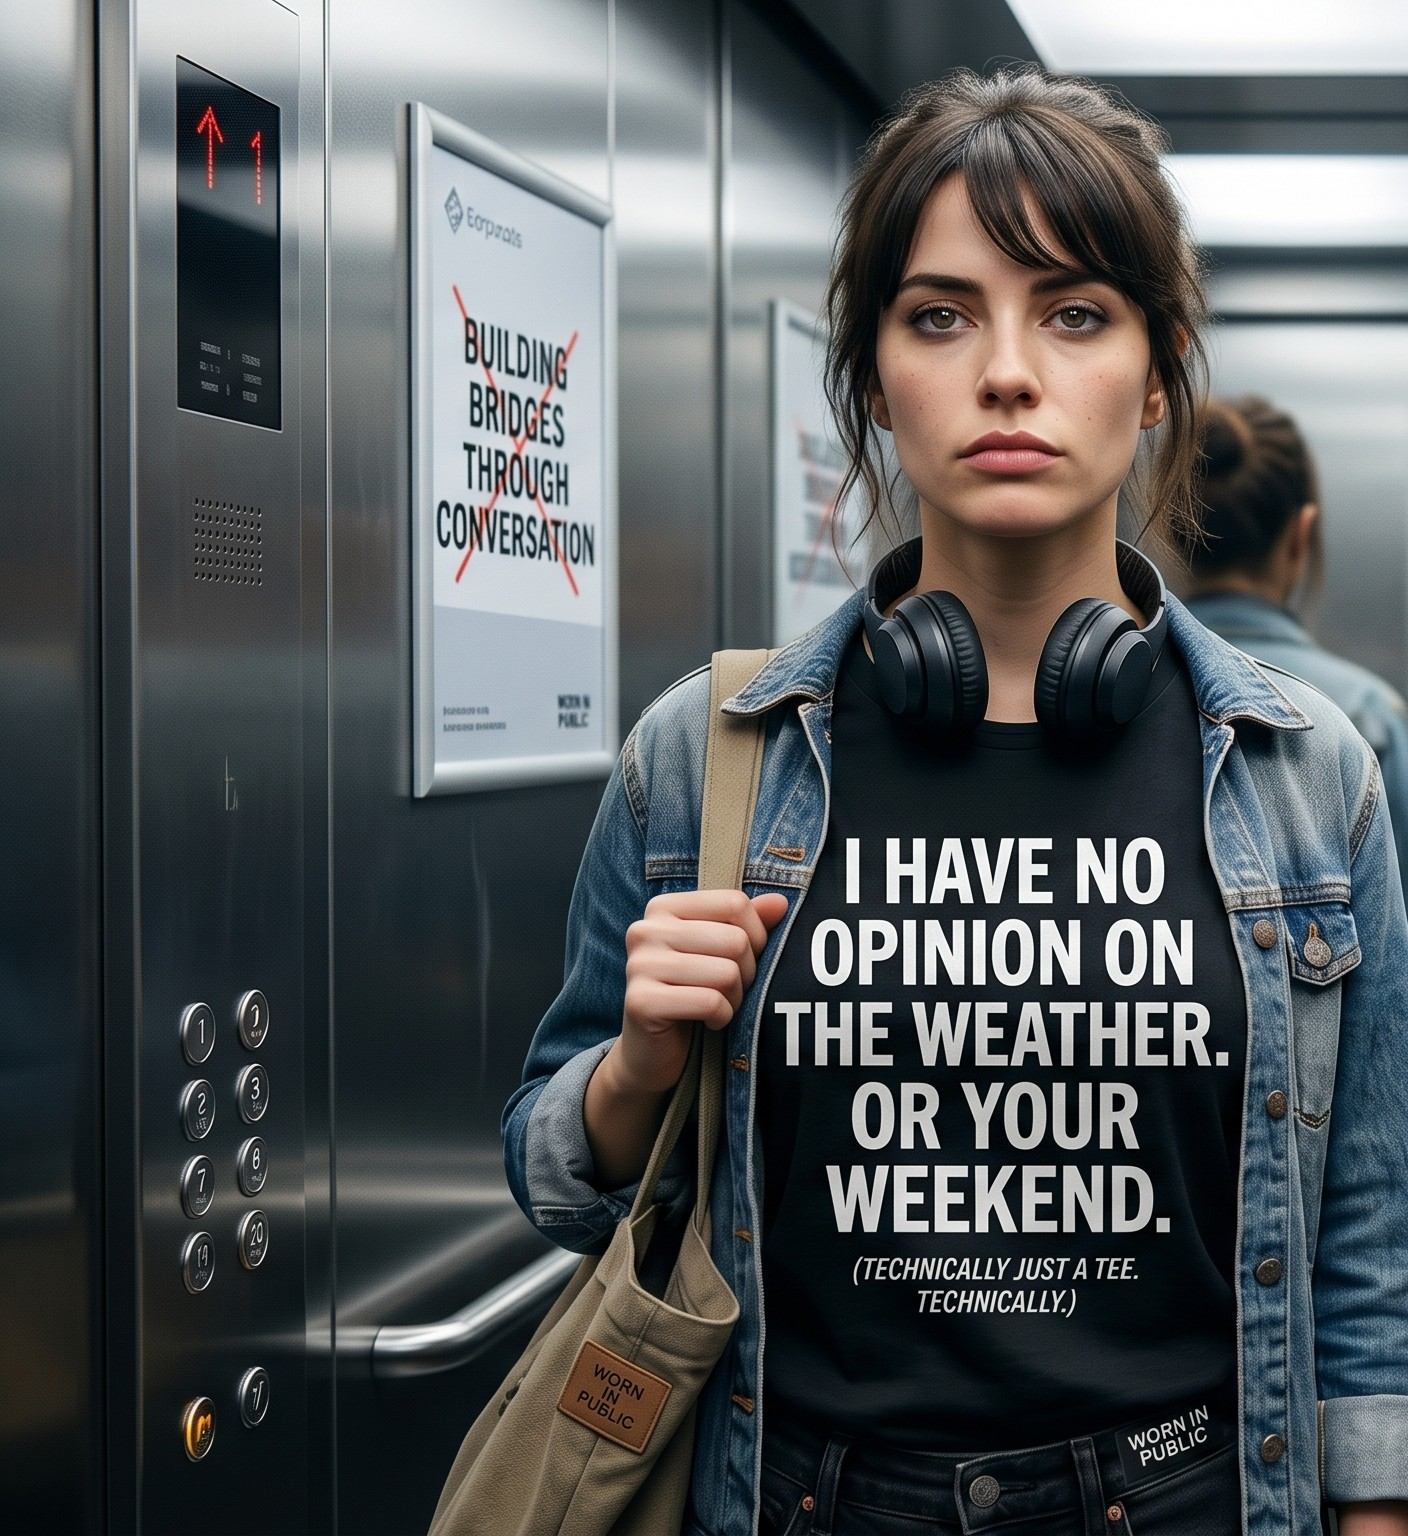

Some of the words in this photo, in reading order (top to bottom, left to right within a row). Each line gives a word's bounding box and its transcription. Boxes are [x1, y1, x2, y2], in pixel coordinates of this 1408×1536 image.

[250, 130, 262, 206] 1
[464, 316, 567, 391] BUILDING
[470, 381, 565, 448] BRIDGES
[463, 442, 569, 506] THROUGH
[436, 500, 595, 567] CONVERSATION
[845, 837, 860, 904] I
[886, 837, 1054, 904] HAVE
[1076, 836, 1165, 905] NO
[810, 918, 1081, 987] OPINION
[1104, 918, 1194, 987] ON
[198, 1018, 205, 1044] 1
[774, 1001, 894, 1067] THE
[911, 1001, 1229, 1067] WEATHER.
[197, 1092, 206, 1115] 2
[251, 1076, 260, 1100] 3
[851, 1081, 941, 1151] OR
[960, 1081, 1140, 1151] YOUR
[198, 1168, 206, 1193] 7
[825, 1164, 1171, 1233] WEEKEND.
[853, 1256, 1011, 1286] (TECHNICALLY
[1013, 1257, 1070, 1280] JUST
[1072, 1257, 1087, 1280] A
[1095, 1257, 1139, 1280] TEE.
[917, 1288, 1077, 1318] TECHNICALLY.)
[594, 1364, 645, 1401] WORN
[601, 1386, 620, 1406] IN
[577, 1390, 635, 1430] PUBLIC
[1127, 1415, 1187, 1451] WORN
[1189, 1404, 1209, 1425] IN
[1139, 1426, 1208, 1467] PUBLIC
